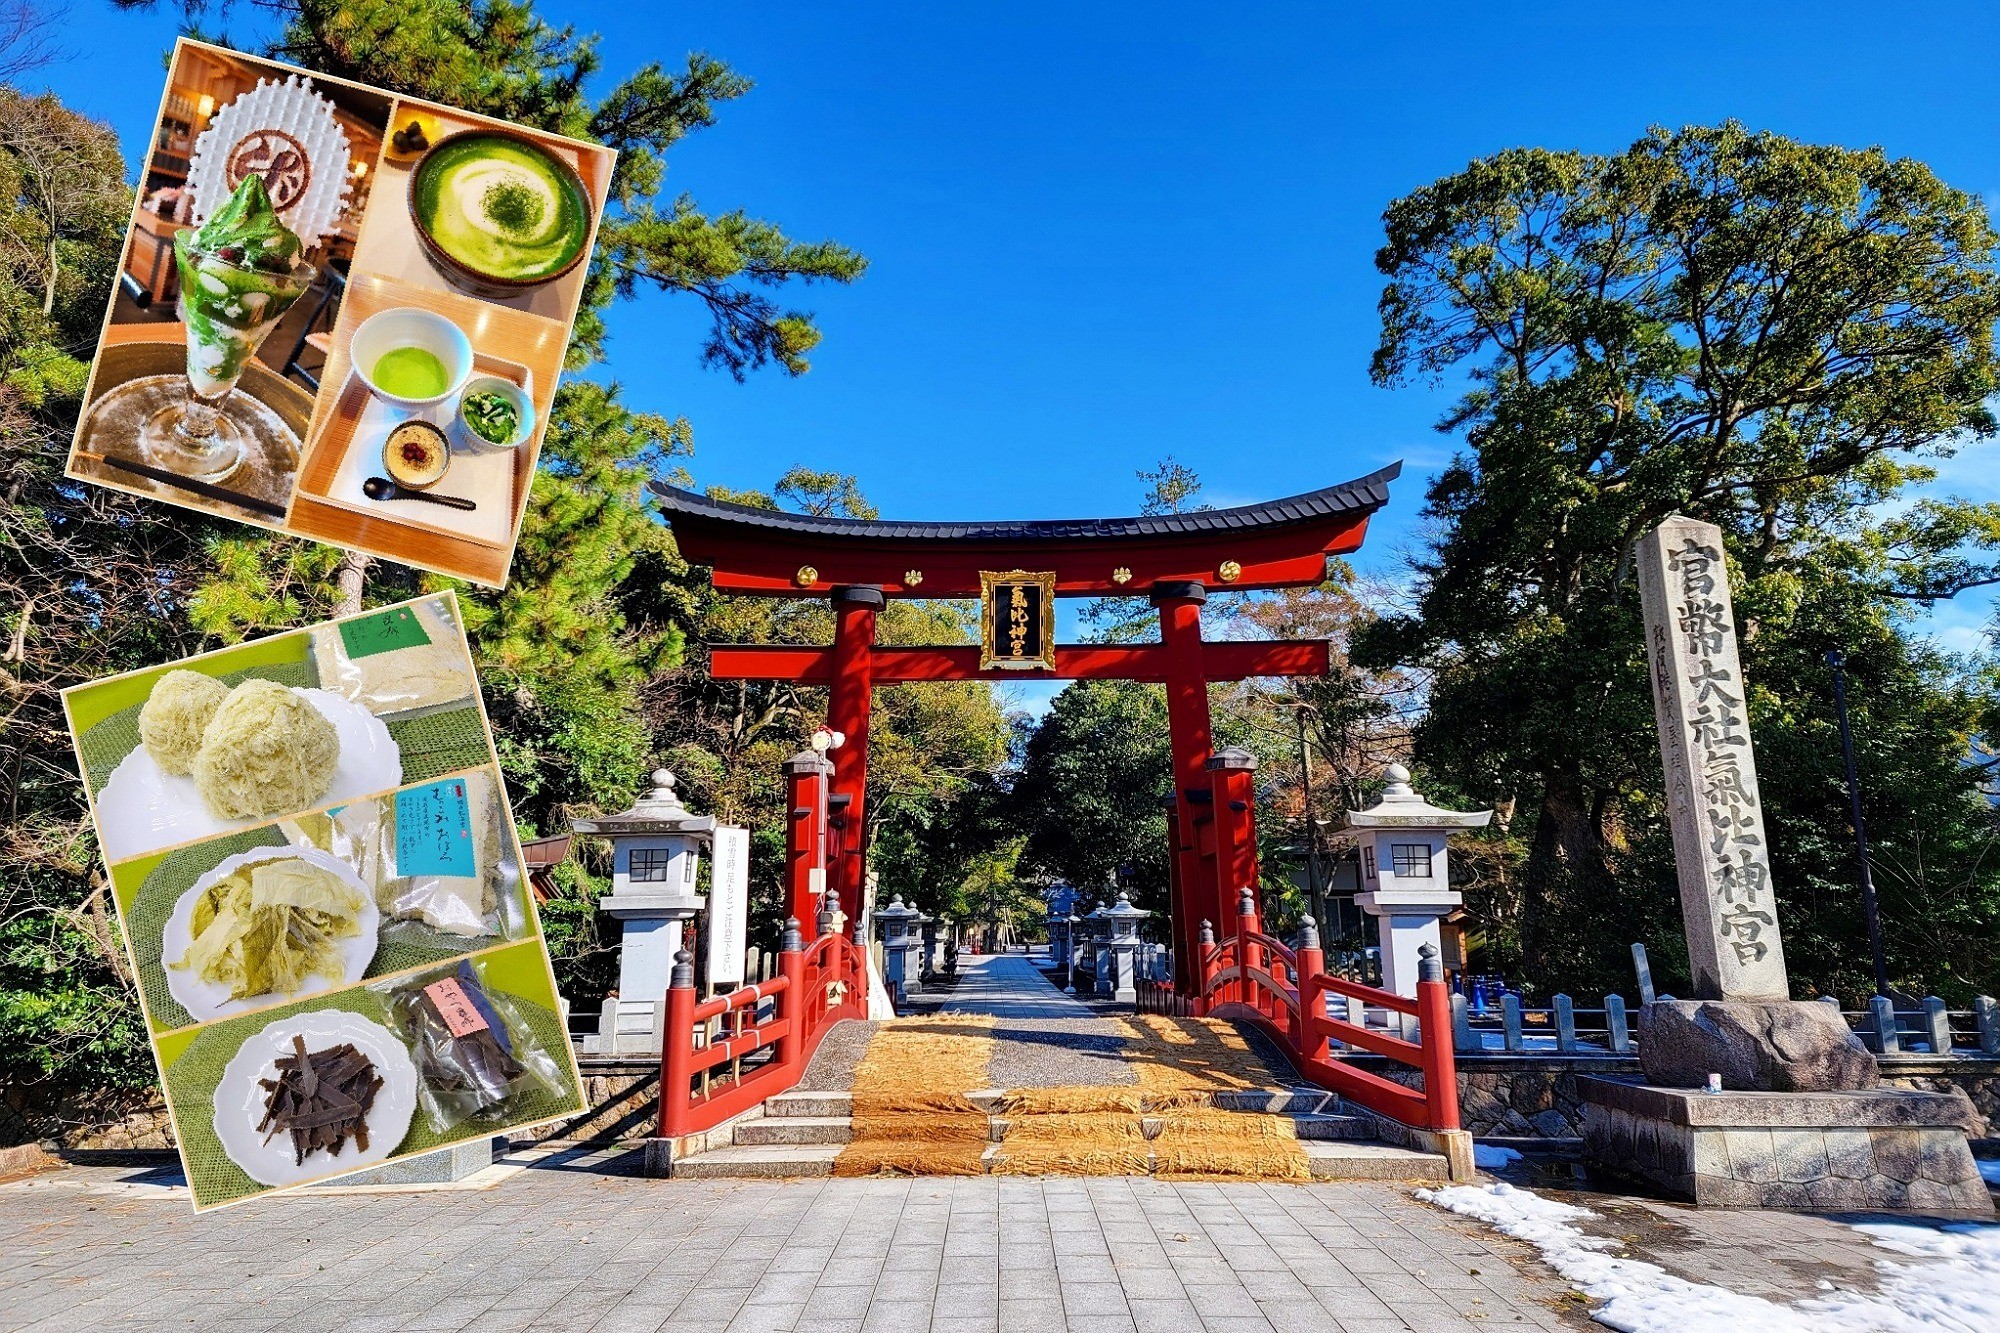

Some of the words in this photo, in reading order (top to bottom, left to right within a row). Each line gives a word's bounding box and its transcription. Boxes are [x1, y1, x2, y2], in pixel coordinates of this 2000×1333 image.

[1008, 585, 1030, 657] 氣比神宮
[1667, 537, 1774, 967] 官幣大社氣比神宮
